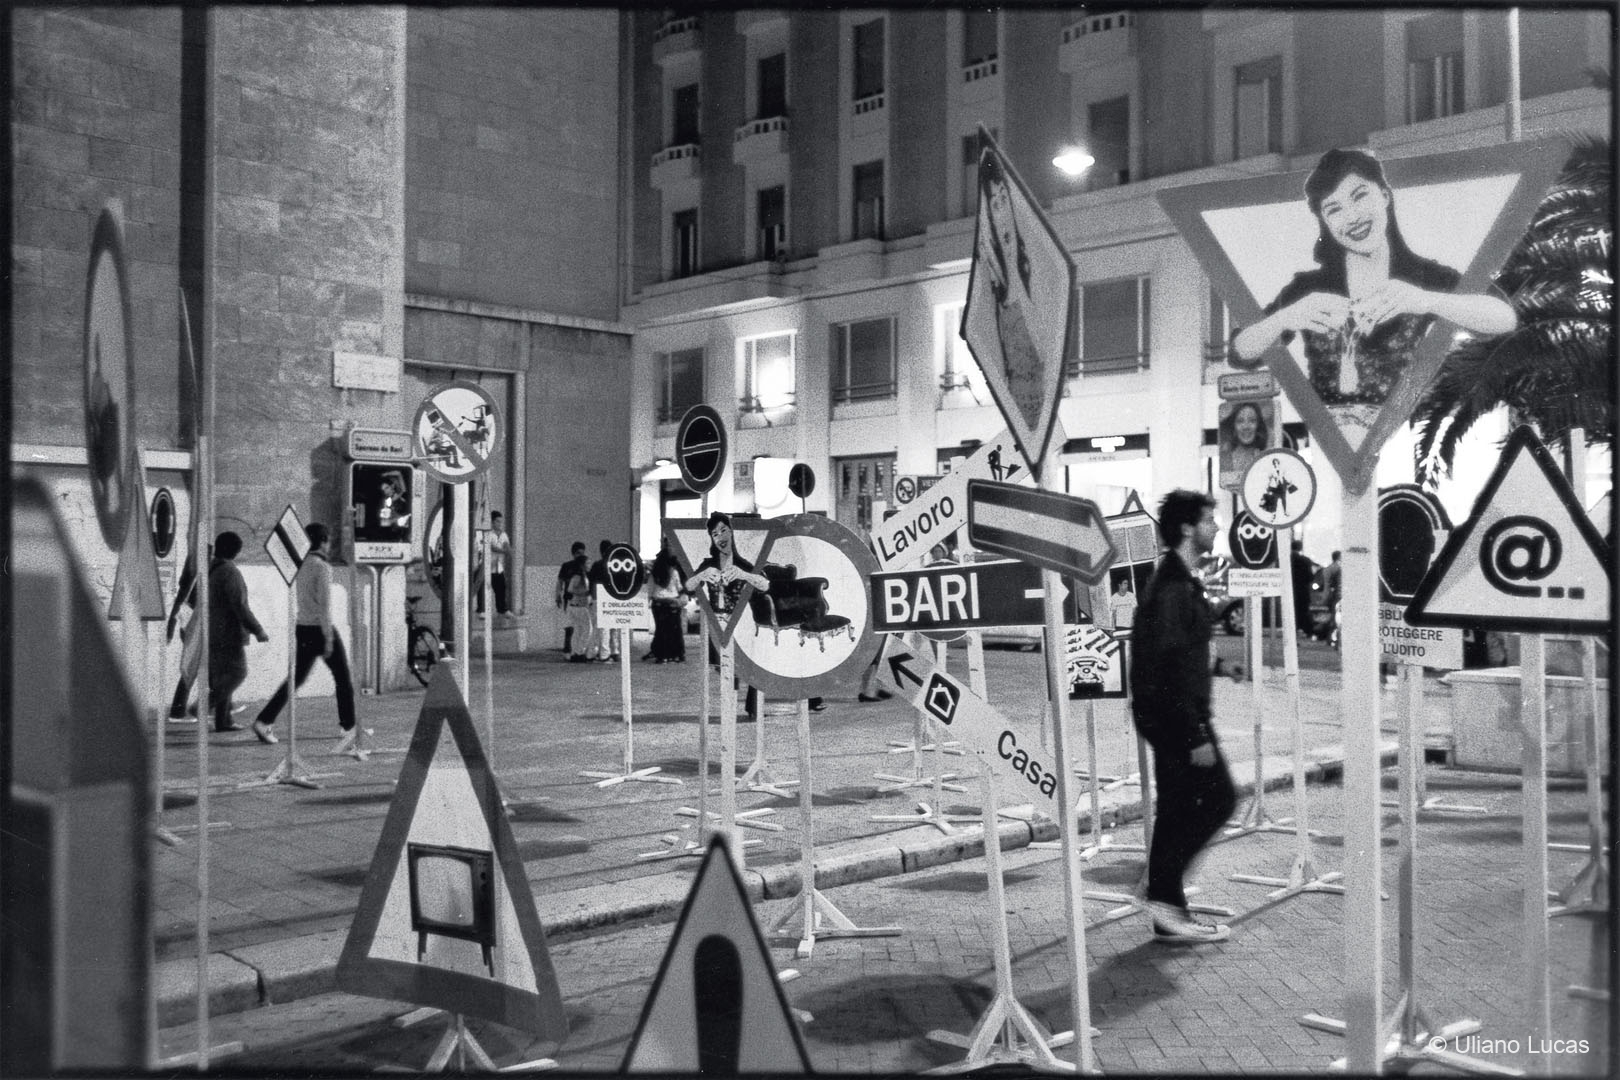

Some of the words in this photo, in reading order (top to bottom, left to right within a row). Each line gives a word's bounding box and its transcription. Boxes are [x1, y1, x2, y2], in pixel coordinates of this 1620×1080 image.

[877, 496, 955, 562] Lavoro
[883, 572, 980, 624] BARI
[1379, 626, 1443, 641] OTEGGERE
[1383, 643, 1426, 657] L'UDITO
[998, 731, 1057, 799] Casa
